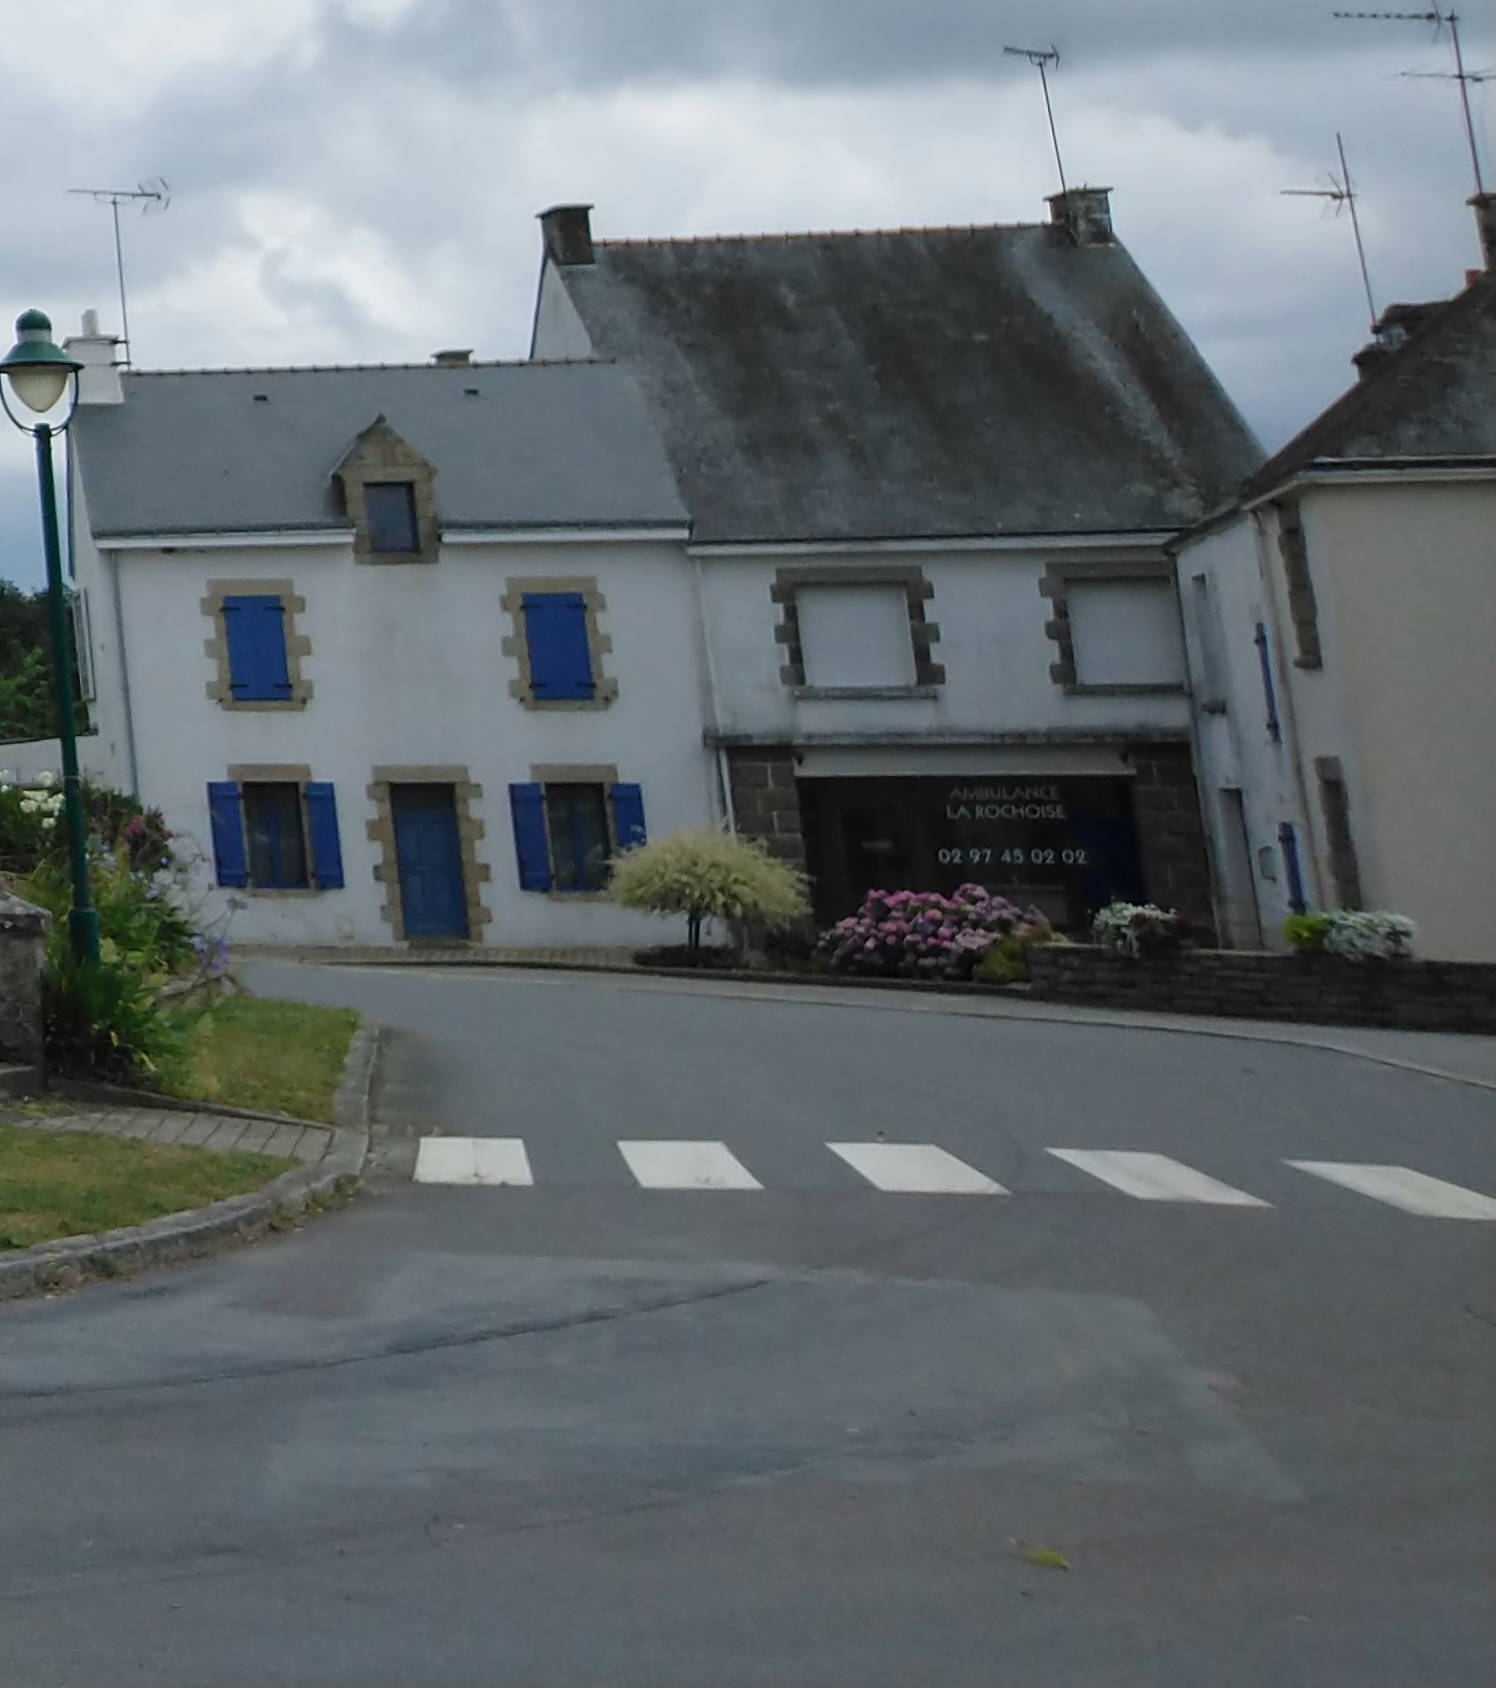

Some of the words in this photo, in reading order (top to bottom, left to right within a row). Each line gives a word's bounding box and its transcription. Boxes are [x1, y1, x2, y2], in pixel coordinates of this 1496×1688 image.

[949, 785, 1060, 801] AMBULANCE
[946, 804, 971, 819] LA
[975, 804, 1067, 819] ROCHOISE
[938, 848, 963, 865] 02
[969, 848, 992, 865] 97
[1000, 848, 1024, 865] 45
[1030, 848, 1055, 865] 02
[1061, 848, 1087, 865] 02
